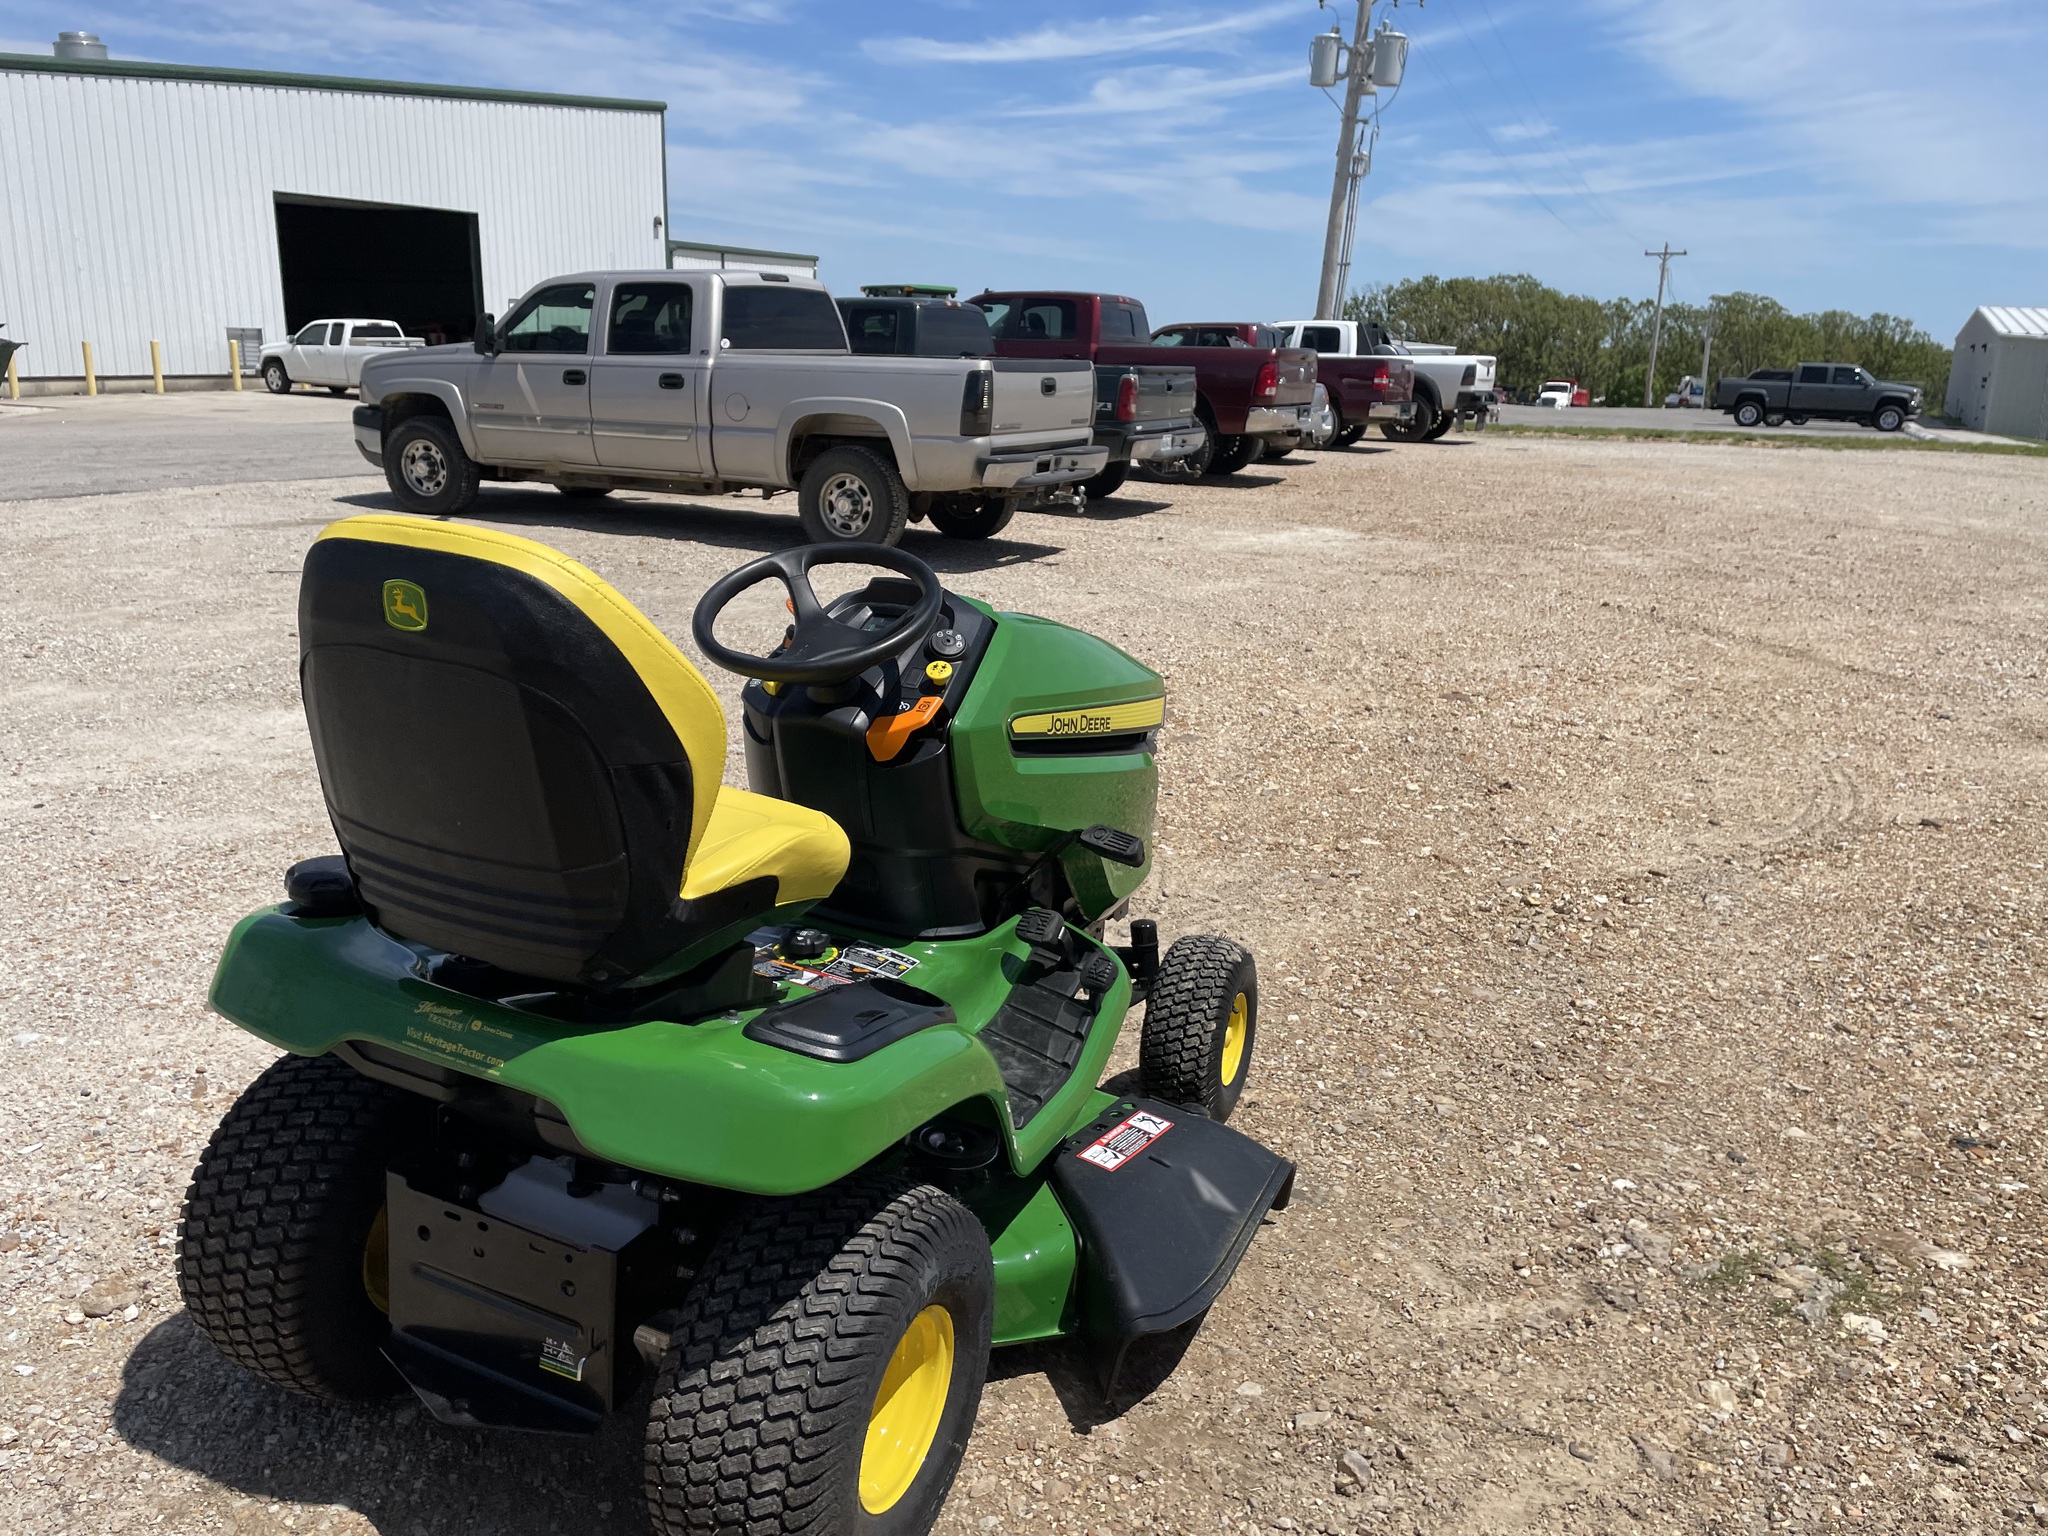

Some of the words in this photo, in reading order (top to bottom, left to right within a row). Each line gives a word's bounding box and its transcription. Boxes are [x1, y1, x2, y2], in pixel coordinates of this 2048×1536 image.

[1047, 715, 1078, 733] JOHN
[1079, 714, 1111, 732] DEERE
[414, 1000, 463, 1016] Heritage
[428, 1014, 464, 1031] TRACTOR
[406, 1026, 423, 1040] Visit
[423, 1032, 505, 1068] HeritageTractor.com
